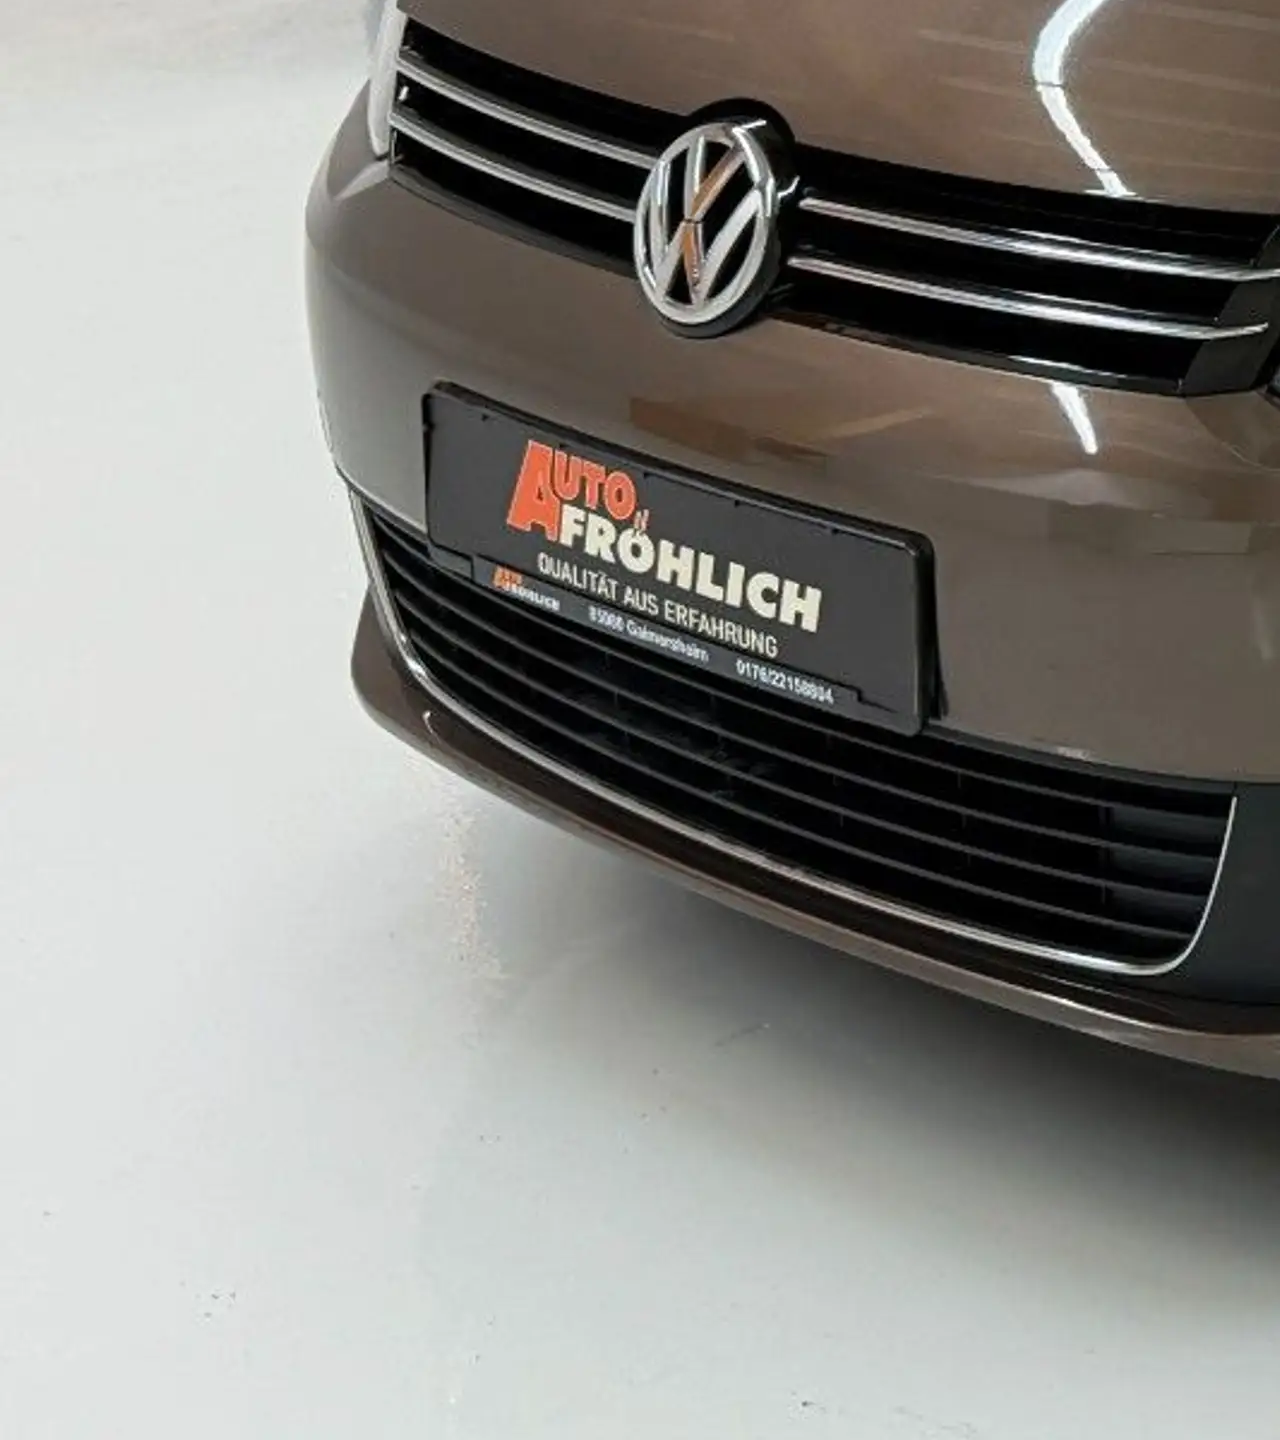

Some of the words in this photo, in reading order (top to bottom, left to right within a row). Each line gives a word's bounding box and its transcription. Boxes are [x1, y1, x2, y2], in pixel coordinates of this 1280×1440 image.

[506, 439, 636, 541] AUTO
[537, 552, 618, 601] QUALITÄT
[623, 585, 659, 616] AUS
[664, 600, 779, 658] ERFAHRUNG
[559, 509, 823, 633] FRÖHLICH
